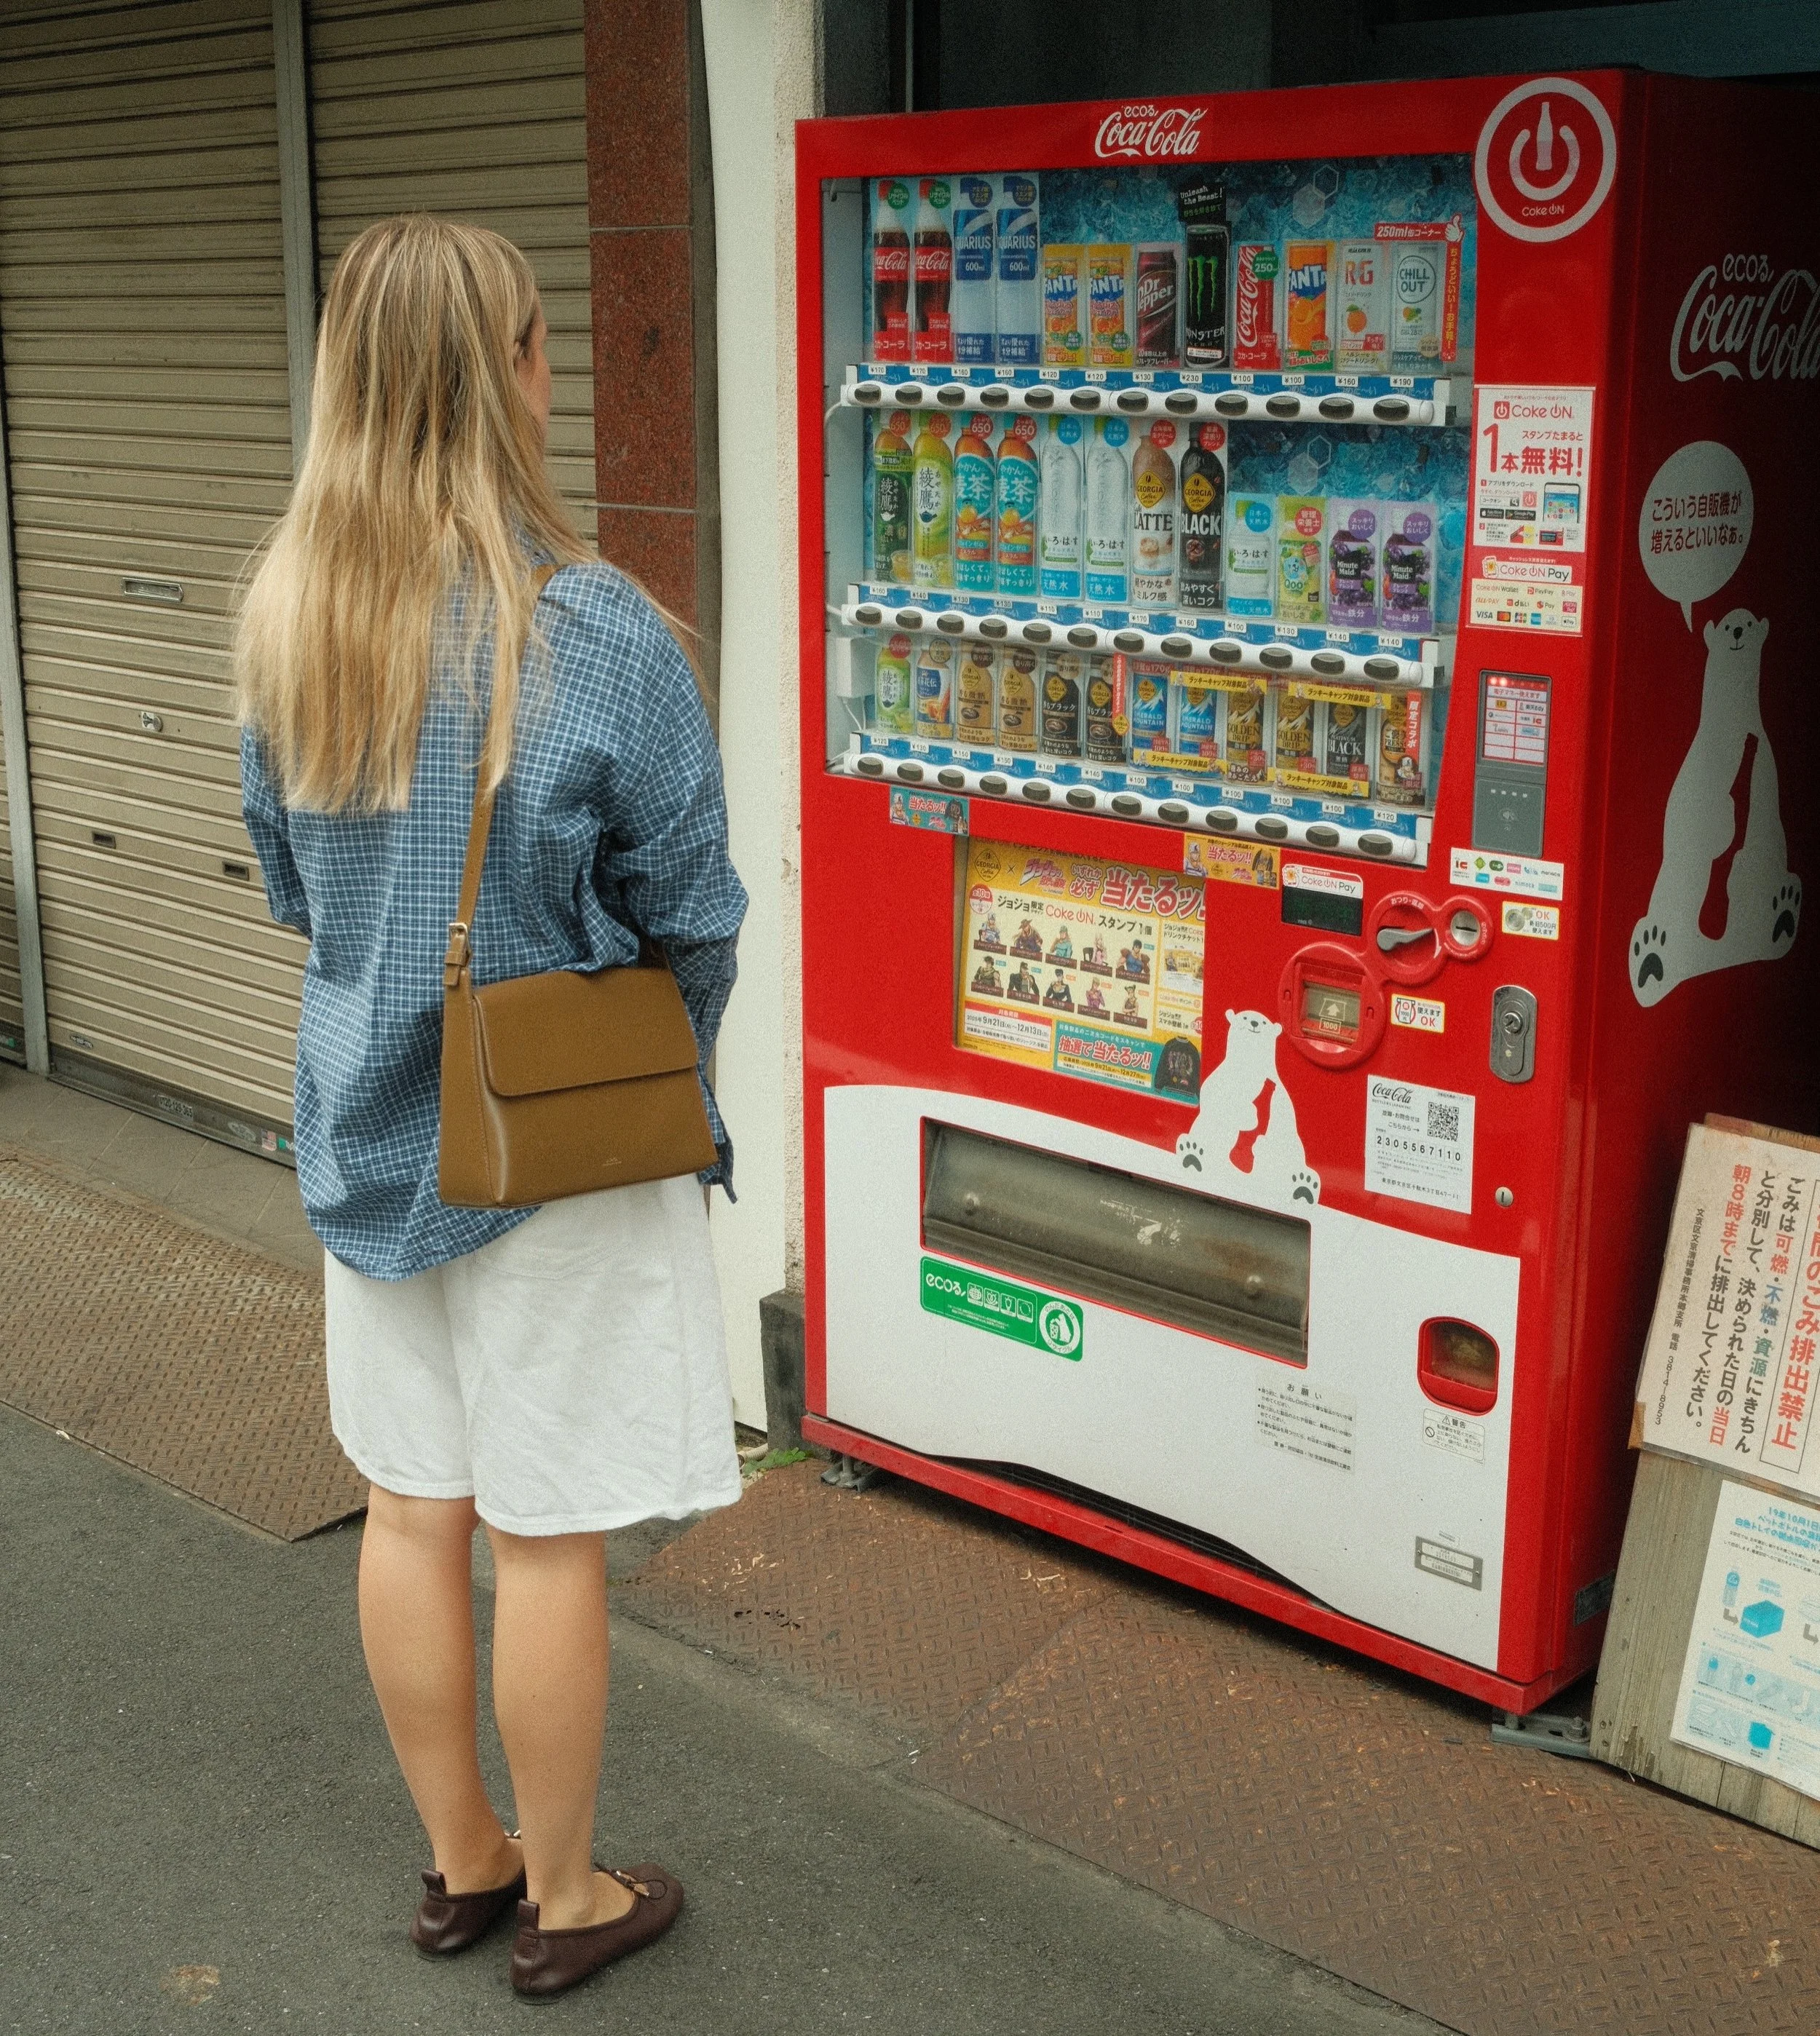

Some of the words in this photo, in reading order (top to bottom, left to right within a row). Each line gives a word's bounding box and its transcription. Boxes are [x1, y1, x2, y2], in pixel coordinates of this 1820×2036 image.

[1095, 108, 1208, 157] Coca-Cola
[1180, 186, 1208, 199] Unleash
[1184, 197, 1197, 206] the
[1522, 206, 1547, 216] Coke
[1400, 268, 1430, 280] CHILL
[1401, 281, 1425, 293] OUT
[870, 366, 885, 374] ¥170
[911, 367, 926, 375] ¥170
[997, 368, 1012, 376] ¥160
[1042, 370, 1058, 378] ¥120
[1135, 373, 1151, 381] ¥130
[1182, 375, 1199, 383] ¥230
[1512, 405, 1547, 419] Coke
[972, 424, 990, 433] 650
[1016, 427, 1034, 435] 650
[1522, 430, 1583, 441] スタンプたまると
[919, 467, 935, 510] 綾鷹
[1653, 491, 1743, 522] こういう自販機が
[1134, 512, 1172, 531] LATTE
[1181, 514, 1221, 536] BLACK
[1337, 561, 1358, 569] Minute
[1391, 565, 1412, 574] Minute
[1340, 568, 1356, 576] Maid
[1393, 571, 1411, 580] Maid
[1500, 565, 1527, 576] Coke
[1548, 568, 1569, 582] Pay
[1285, 580, 1302, 589] Qoo
[1040, 605, 1055, 613] ¥110
[1132, 615, 1147, 623] ¥170
[1476, 611, 1493, 619] VISA
[1178, 619, 1195, 627] ¥160
[1277, 627, 1295, 635] ¥130
[1329, 633, 1347, 641] ¥140
[913, 744, 927, 752] ¥130
[1328, 740, 1362, 755] BLACK
[997, 756, 1011, 764] ¥150
[1037, 764, 1053, 772] ¥140
[1129, 777, 1144, 785] ¥100
[1175, 783, 1190, 791] ¥100
[1274, 797, 1290, 805] ¥100
[976, 860, 1000, 870] GEORGIA
[1069, 876, 1101, 900] 必ず
[1302, 876, 1322, 887] Coke
[1339, 882, 1356, 894] Pay
[997, 895, 1030, 912] ジョジョ
[1045, 904, 1074, 920] Coke
[1535, 910, 1550, 920] OK
[1420, 1016, 1436, 1027] OK
[1322, 1023, 1339, 1031] 1000
[1372, 1083, 1414, 1104] Coca-Cola
